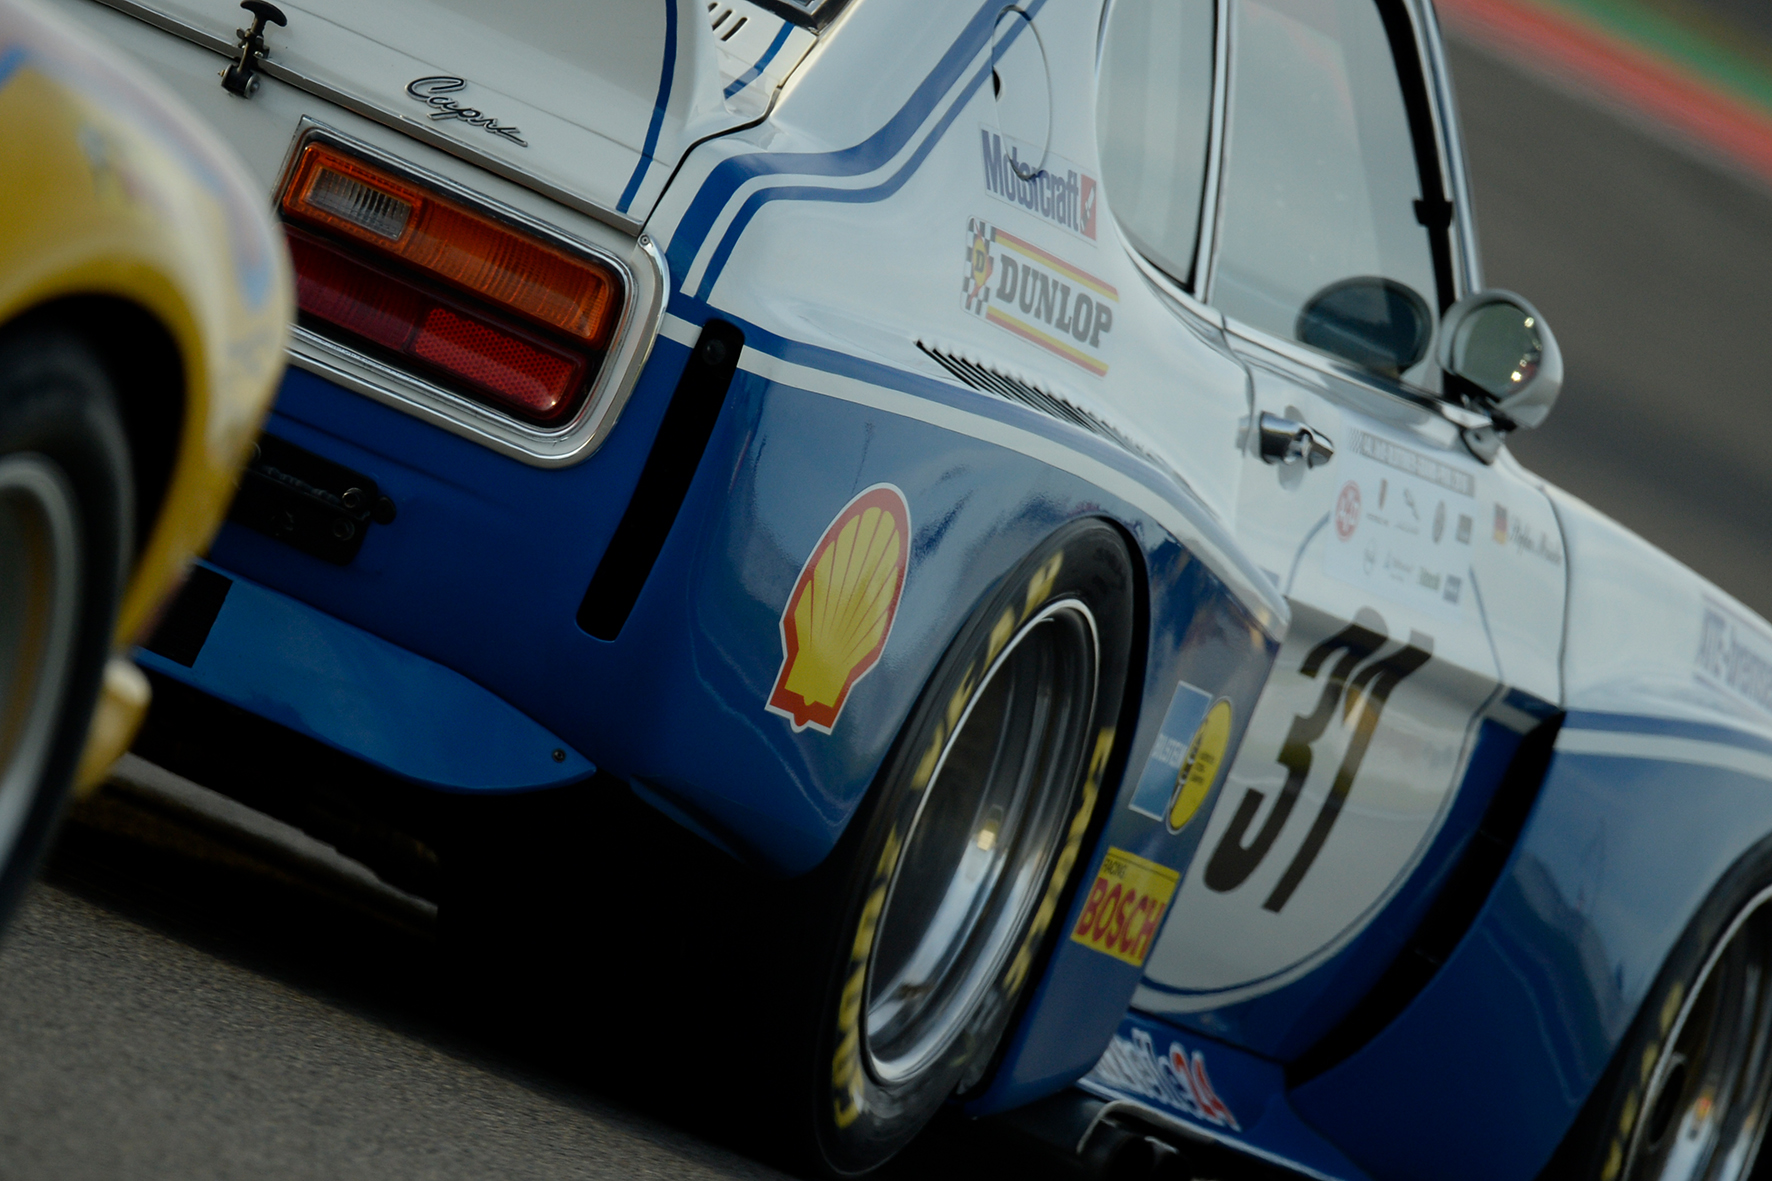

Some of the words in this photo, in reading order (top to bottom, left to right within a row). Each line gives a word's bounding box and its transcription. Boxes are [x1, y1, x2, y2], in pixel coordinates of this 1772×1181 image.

[404, 75, 529, 148] Capri
[981, 128, 1080, 234] Motorcraft
[996, 253, 1113, 349] DUNLOP
[1203, 606, 1436, 915] 31
[1075, 875, 1166, 962] BOSCH
